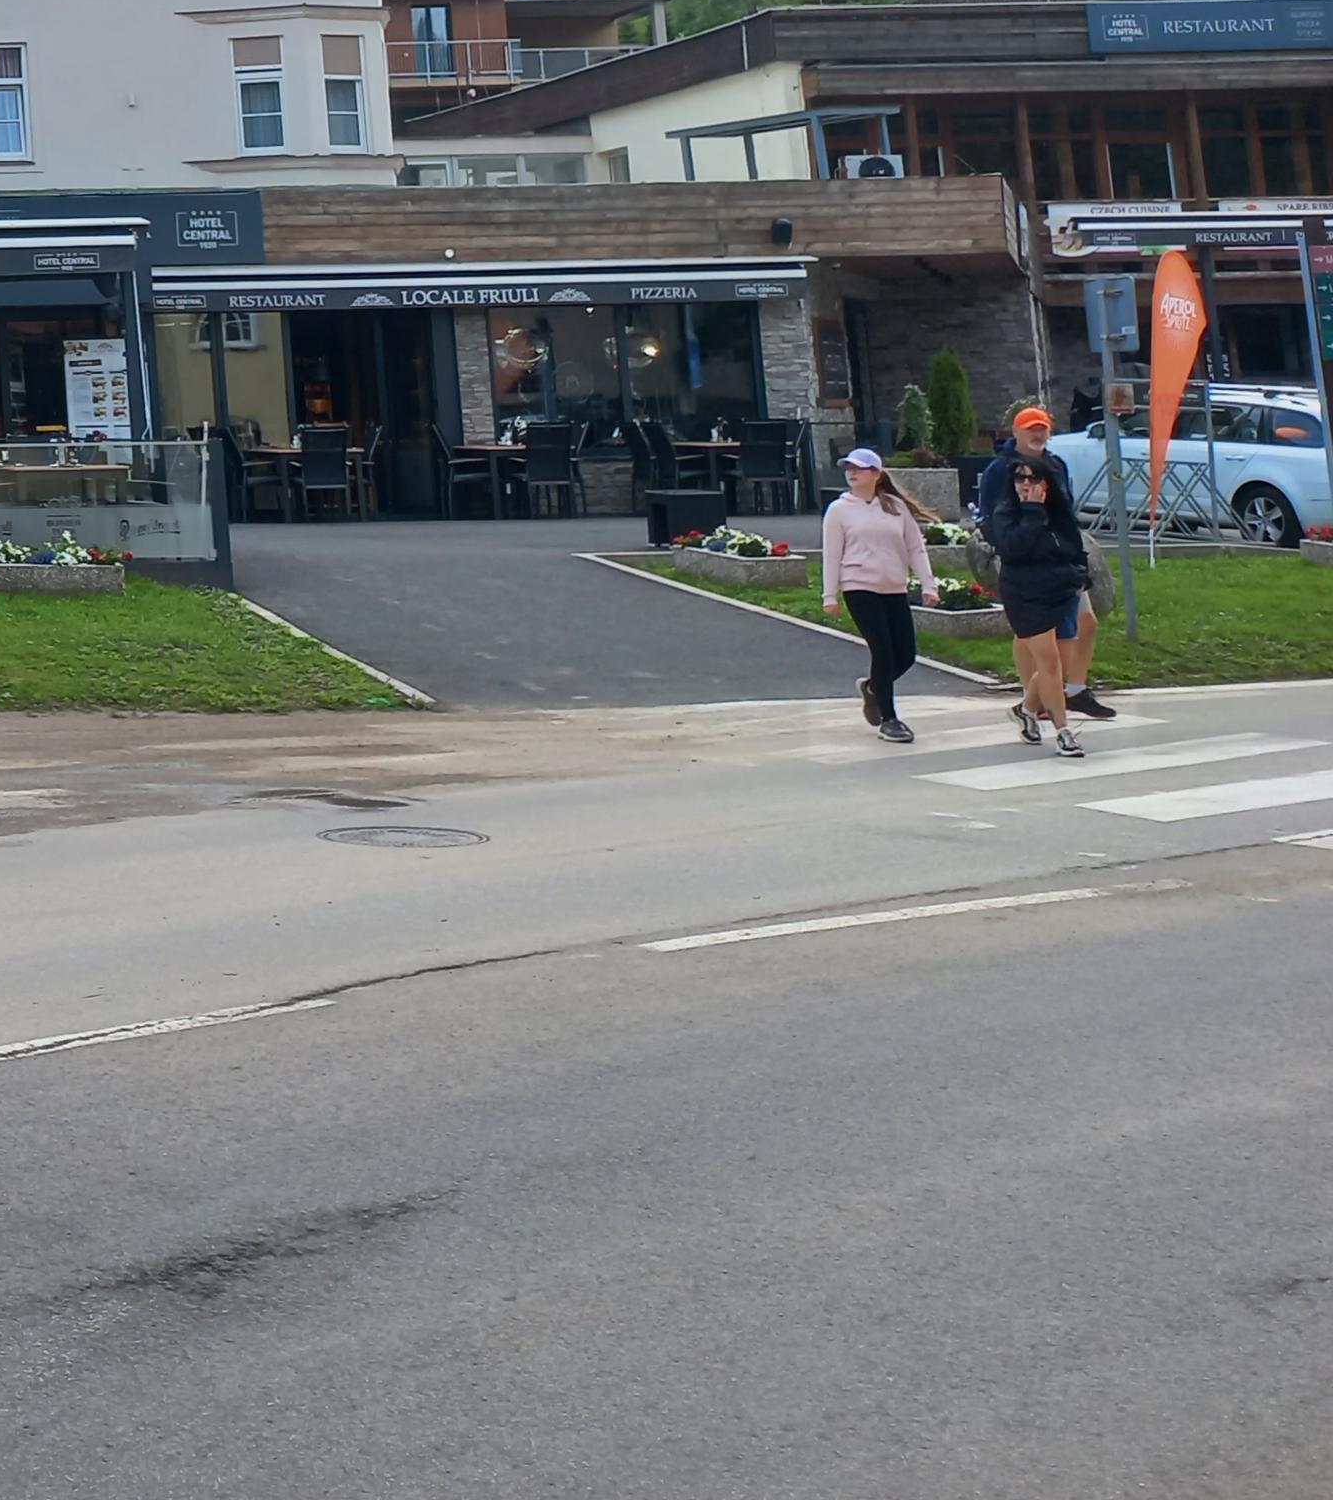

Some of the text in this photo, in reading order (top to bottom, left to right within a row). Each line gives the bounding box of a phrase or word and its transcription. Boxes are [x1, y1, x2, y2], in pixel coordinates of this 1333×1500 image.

[1162, 18, 1275, 34] RESTAURANT
[189, 217, 224, 229] HOTEL
[183, 229, 232, 241] CENTRAL
[1195, 232, 1272, 243] RESTAURANT
[37, 257, 96, 266] HOTEL CENTRAL
[401, 288, 540, 306] LOCALE FRIULI
[630, 286, 697, 300] PIZZERIA
[228, 294, 326, 308] RESTAURANT
[1160, 292, 1197, 318] APEROL
